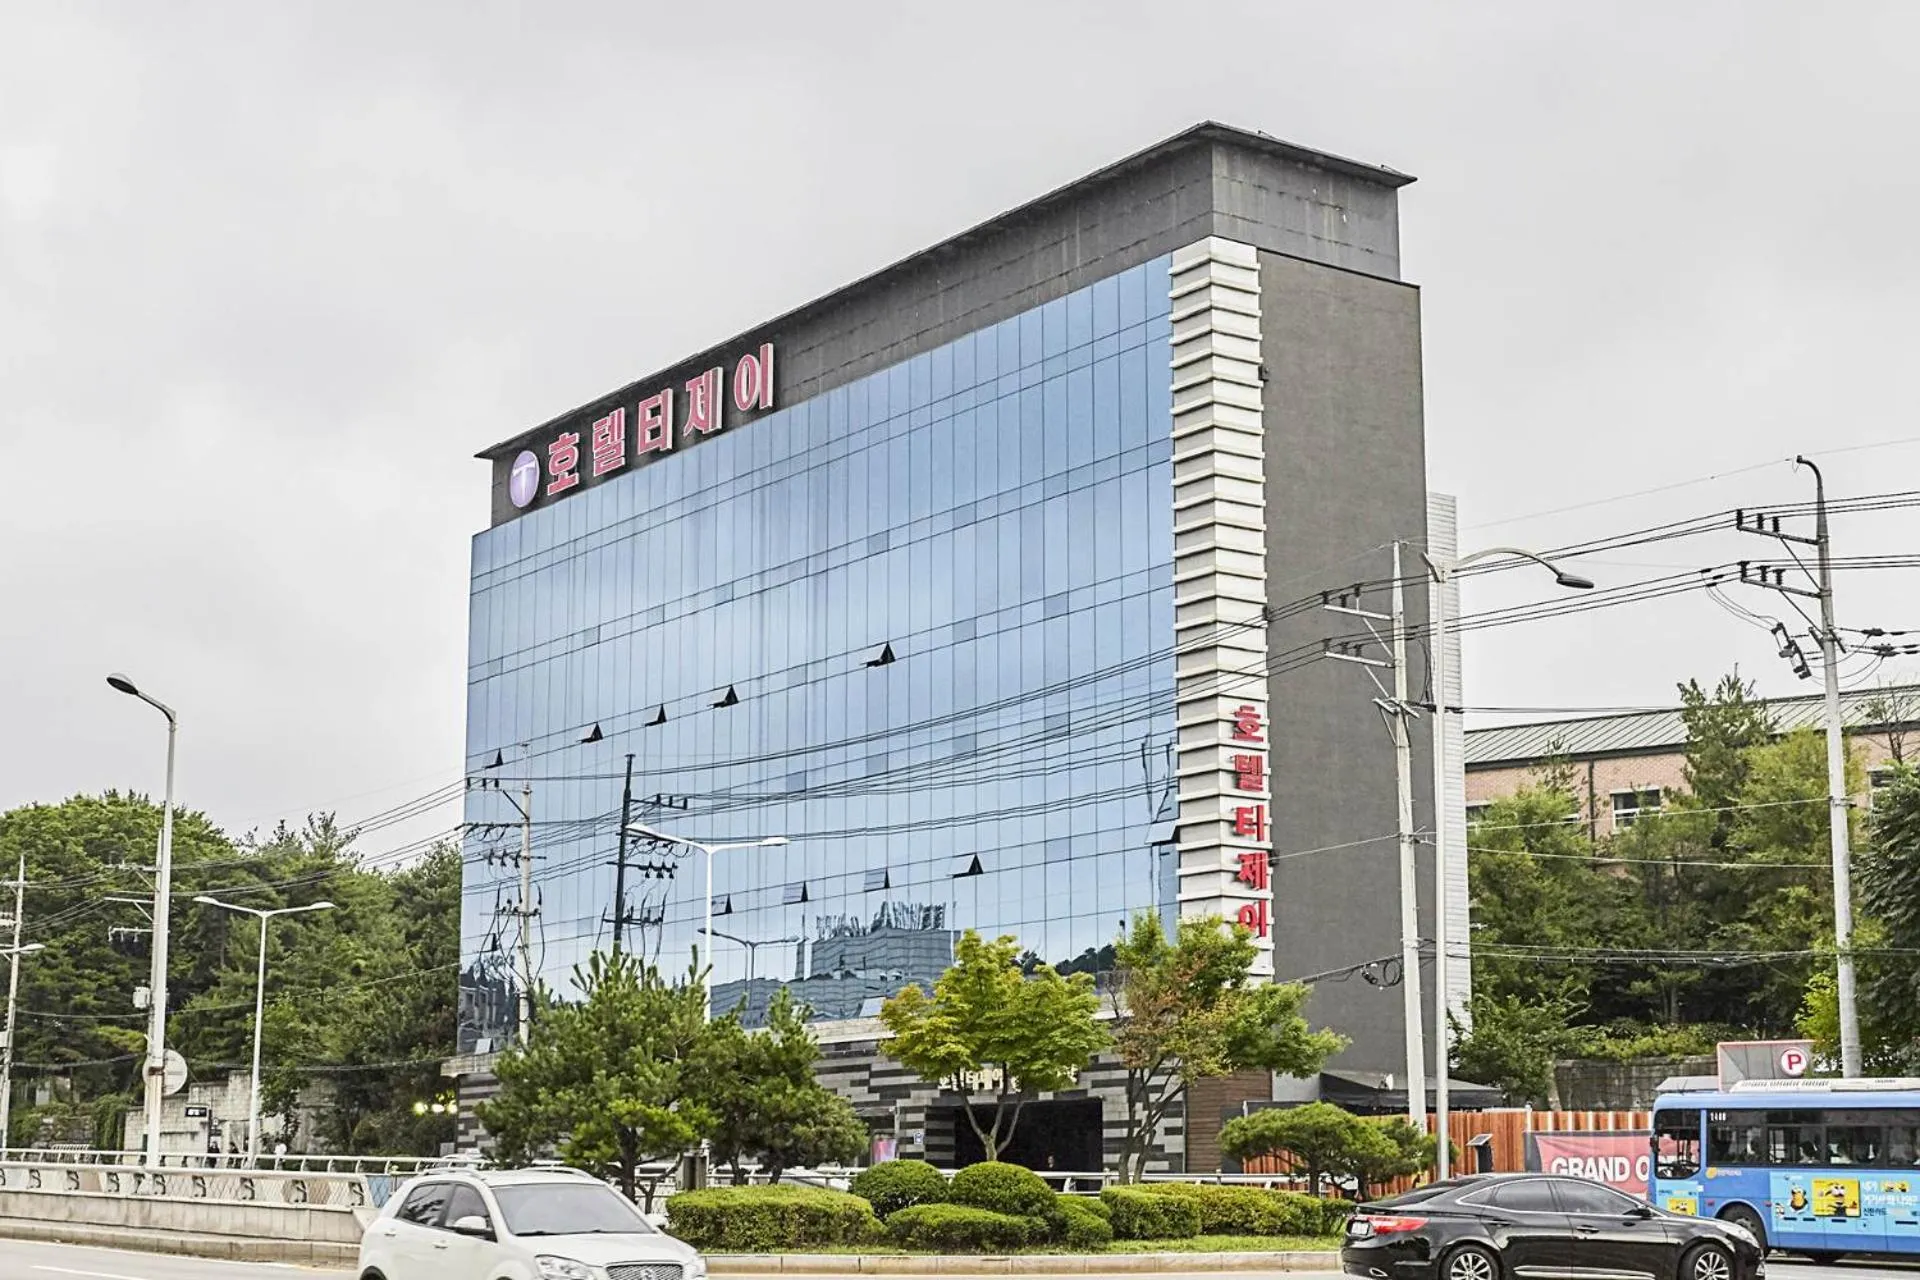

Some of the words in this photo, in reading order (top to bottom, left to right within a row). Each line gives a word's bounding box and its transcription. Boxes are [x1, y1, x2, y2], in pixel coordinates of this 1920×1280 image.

[547, 342, 774, 496] 호텔티제이
[1232, 705, 1268, 938] 호텔티제이
[1787, 1053, 1802, 1070] P
[1551, 1156, 1630, 1182] GRAND
